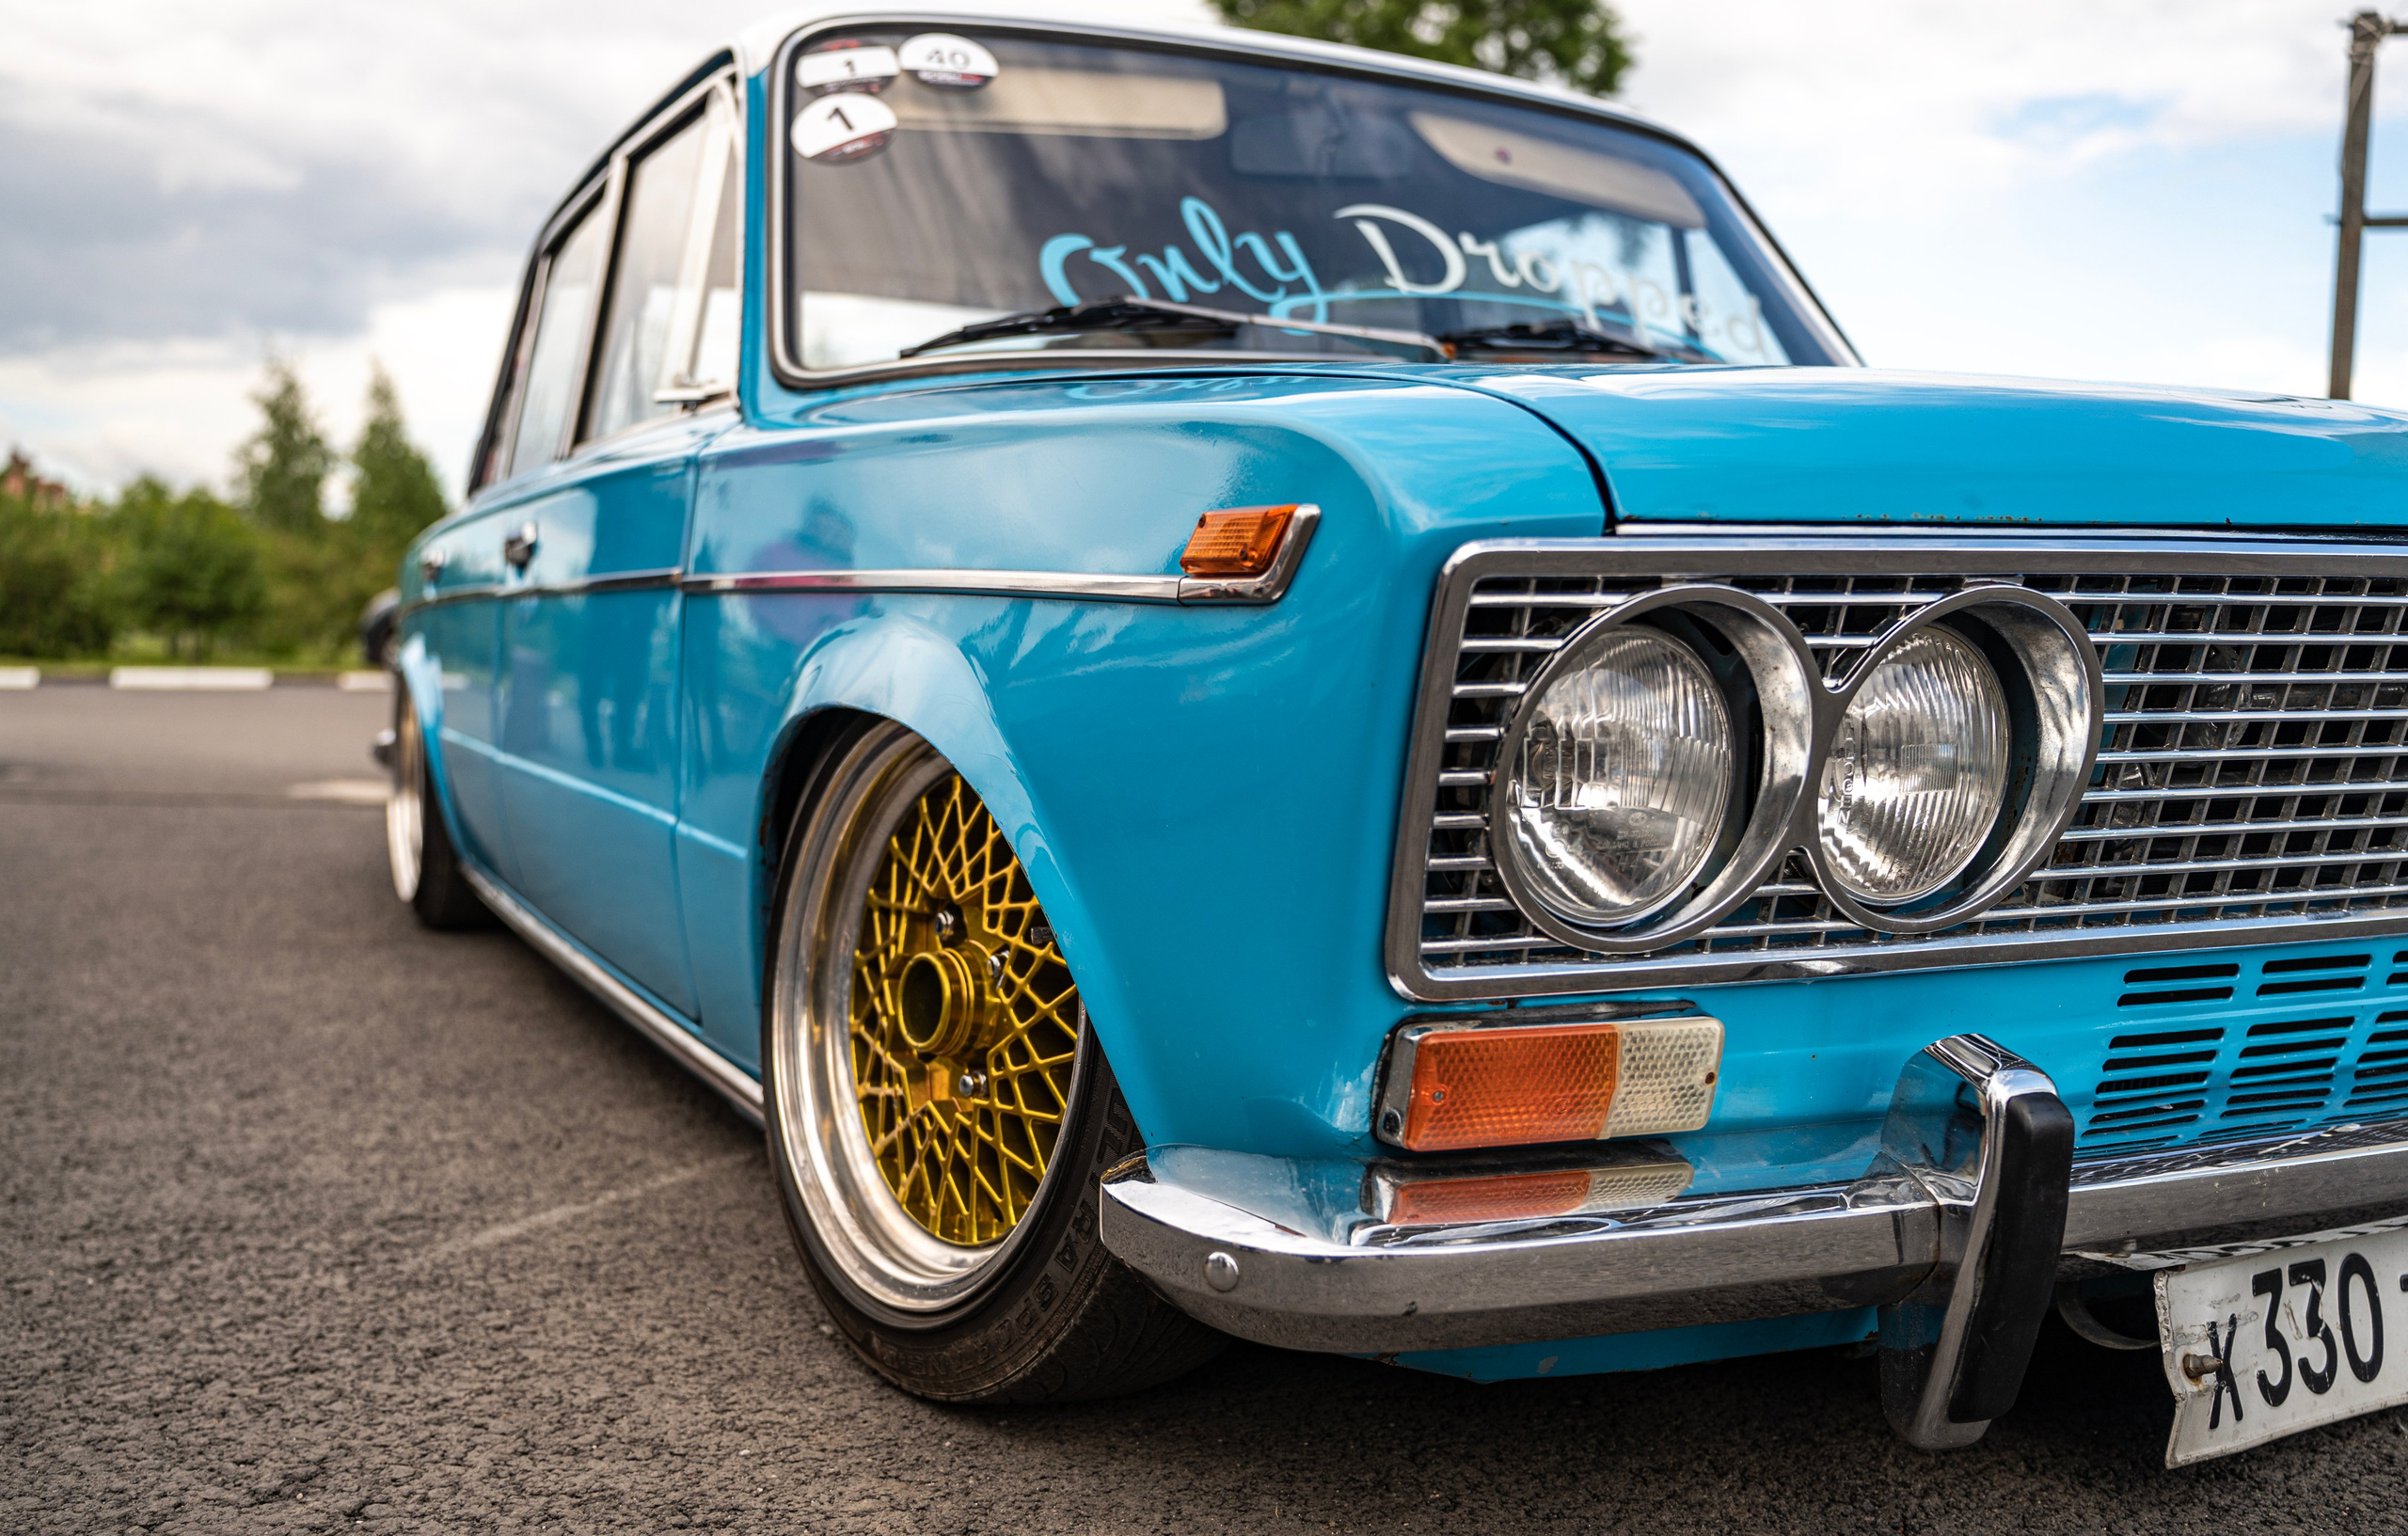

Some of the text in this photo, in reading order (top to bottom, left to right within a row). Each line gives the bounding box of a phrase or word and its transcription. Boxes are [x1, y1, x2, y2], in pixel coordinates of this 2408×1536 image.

[843, 59, 857, 76] 1
[926, 49, 971, 70] 40
[826, 106, 854, 132] 1
[1038, 195, 1768, 363] Only Dropped
[2205, 1251, 2408, 1430] X330
